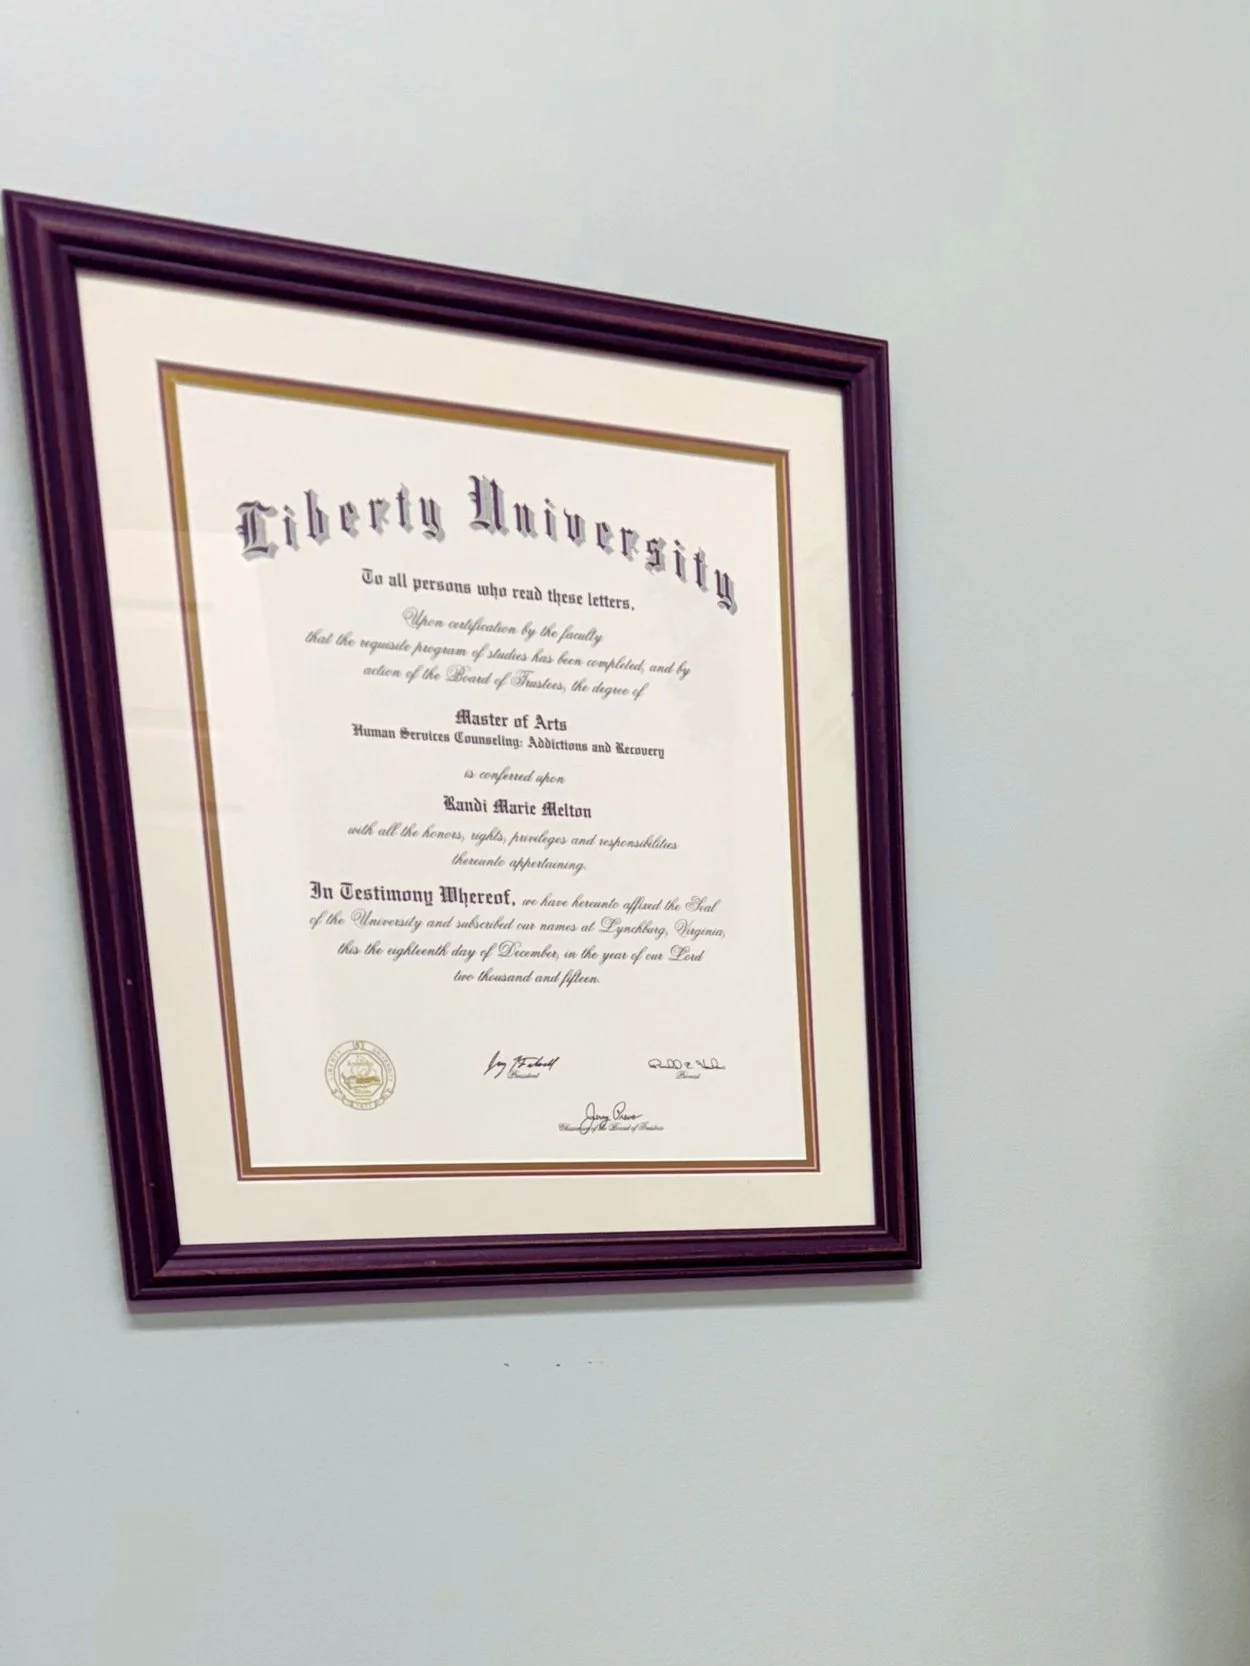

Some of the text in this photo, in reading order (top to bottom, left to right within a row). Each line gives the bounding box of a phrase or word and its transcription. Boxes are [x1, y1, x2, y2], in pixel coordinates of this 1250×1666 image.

[234, 473, 738, 616] Liberty University
[361, 568, 635, 611] To all persons who read these letters,
[402, 607, 604, 647] Upon certification by the faculty
[455, 709, 567, 731] Master of Arts
[352, 724, 665, 759] Human Services Counseling: Addictions and Recovery
[444, 795, 592, 819] Randi Marie Melton
[452, 851, 586, 876] thereunto appertaining.
[309, 881, 334, 899] In
[340, 882, 434, 906] Testimony
[440, 885, 516, 908] Whereof,
[540, 892, 568, 907] have
[571, 893, 620, 909] hereunto
[623, 896, 662, 914] affixed
[664, 898, 680, 911] the
[686, 896, 720, 913] Seal
